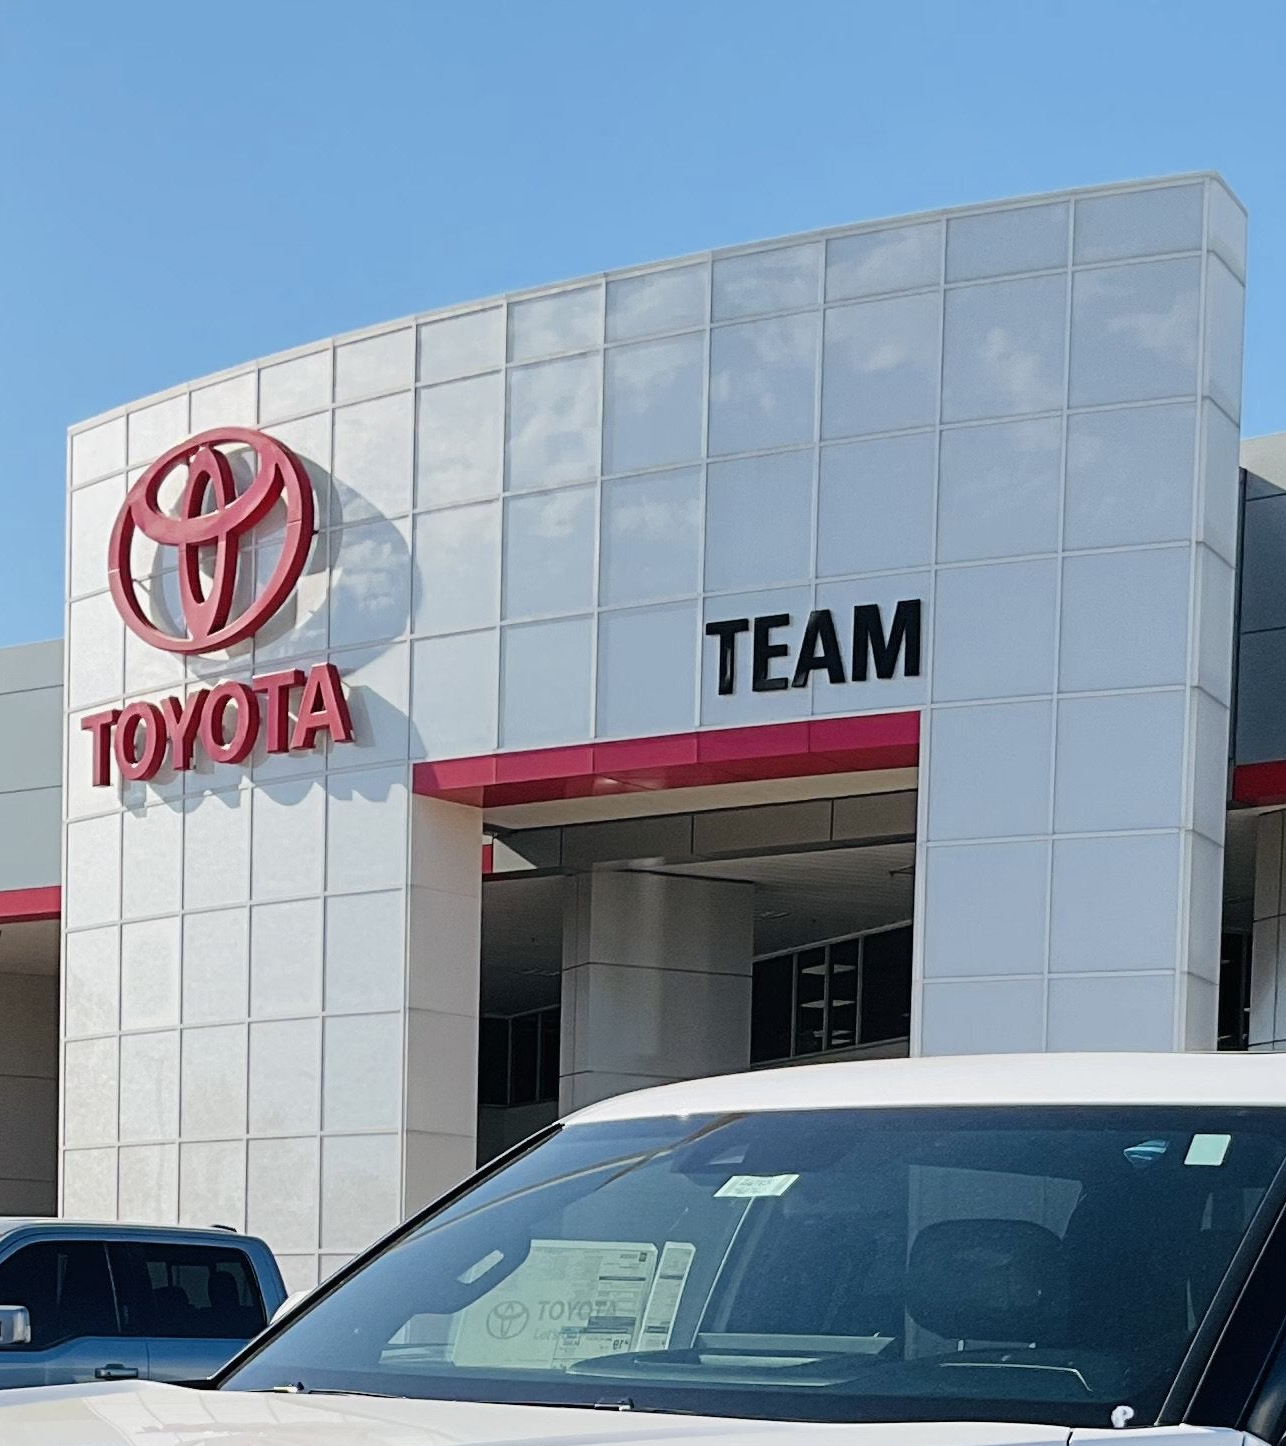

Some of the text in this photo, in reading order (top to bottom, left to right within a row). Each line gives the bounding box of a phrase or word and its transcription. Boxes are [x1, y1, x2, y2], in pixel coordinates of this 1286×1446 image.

[706, 599, 922, 695] TEAM
[81, 663, 354, 787] TOYOTA
[537, 1300, 617, 1321] TOYOTA
